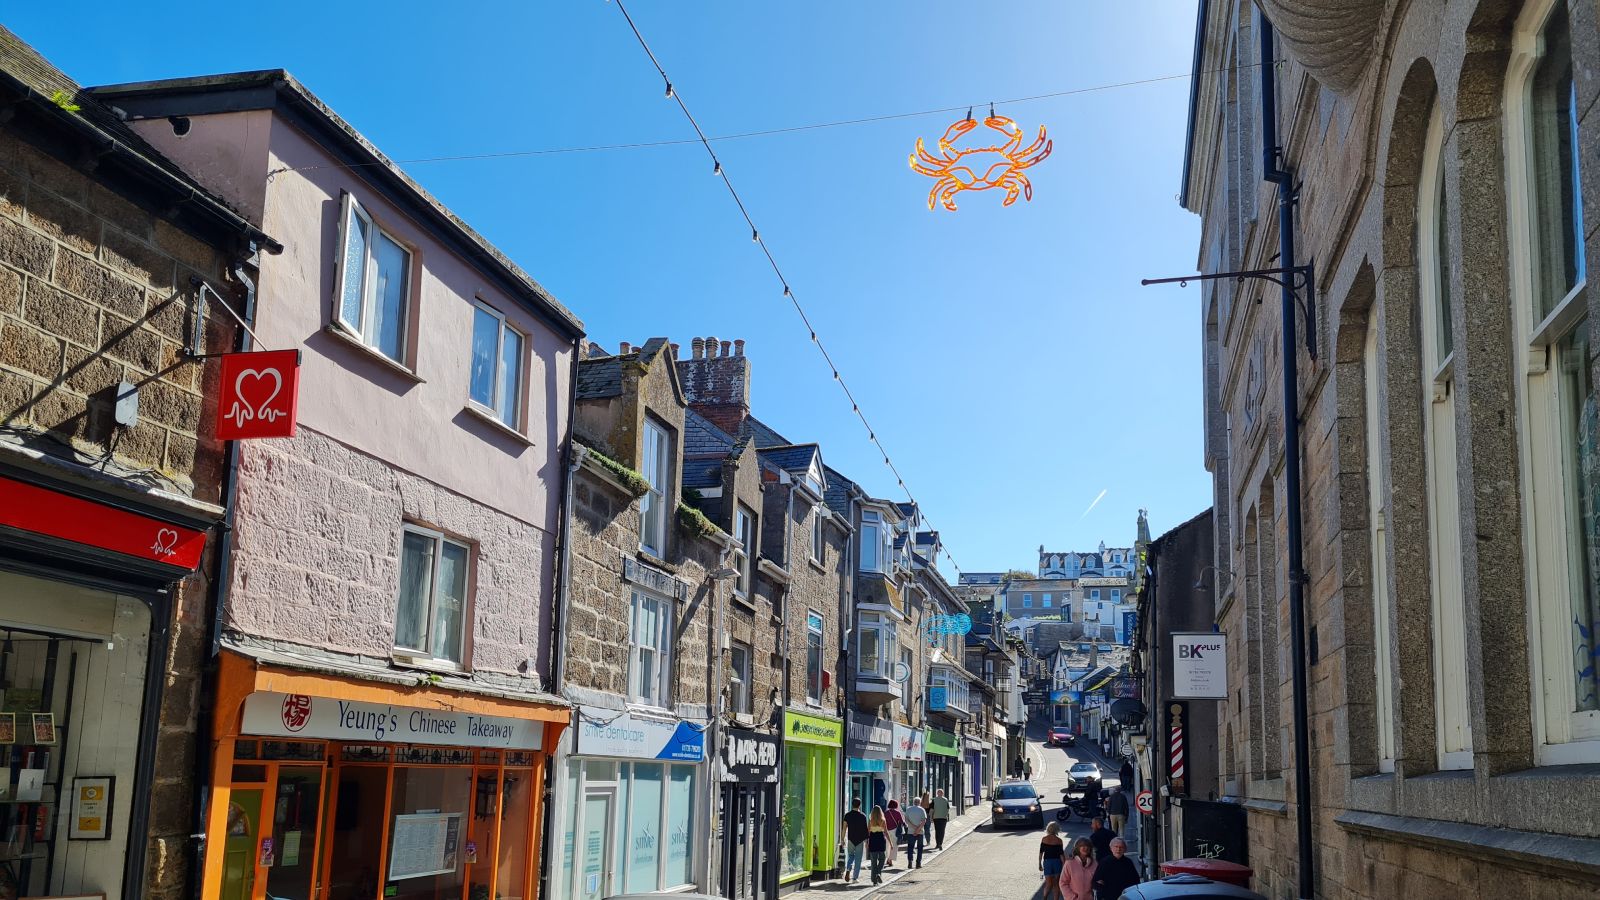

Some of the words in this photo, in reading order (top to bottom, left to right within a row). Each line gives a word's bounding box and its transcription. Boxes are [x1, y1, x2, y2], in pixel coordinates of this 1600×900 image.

[1178, 644, 1203, 658] BK
[337, 700, 397, 740] Yeung's
[409, 710, 457, 735] Chinese
[466, 716, 514, 745] Takeaway
